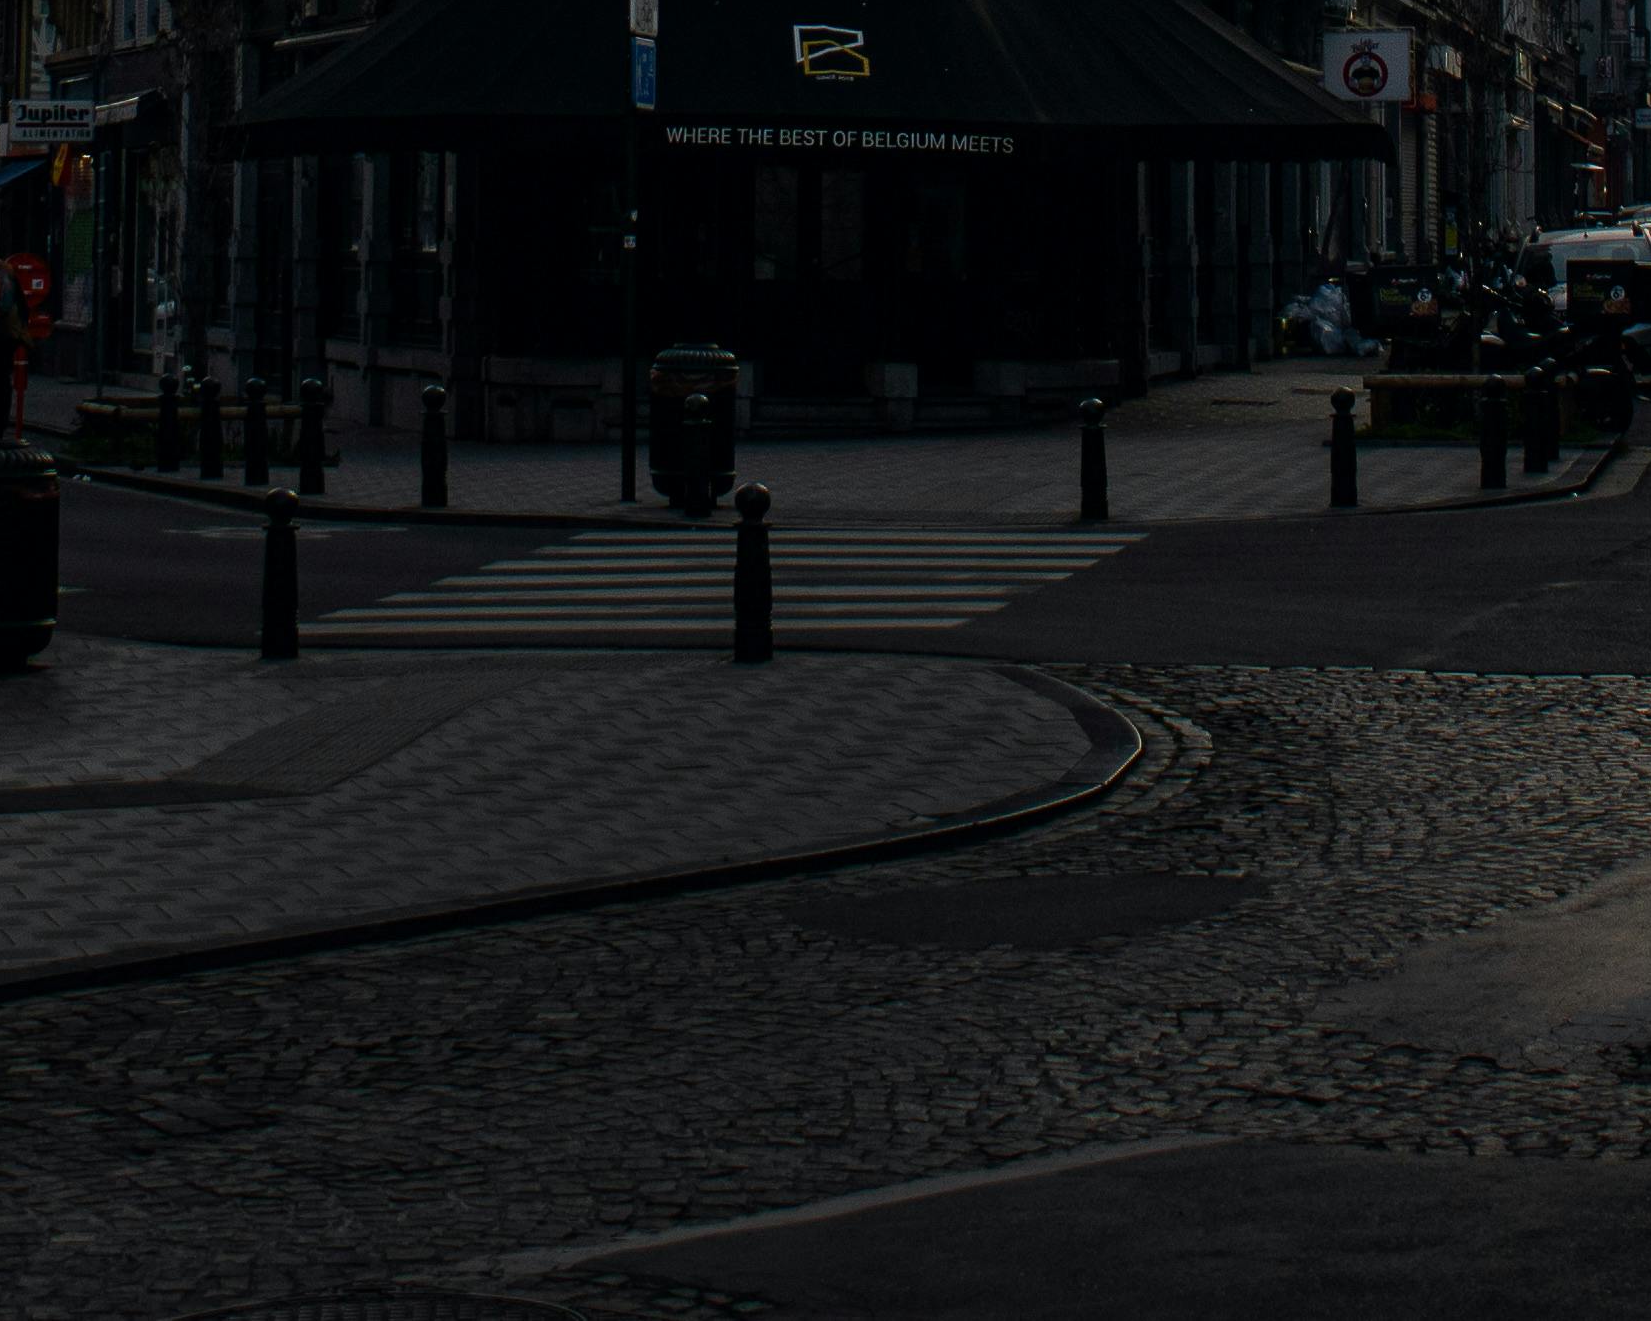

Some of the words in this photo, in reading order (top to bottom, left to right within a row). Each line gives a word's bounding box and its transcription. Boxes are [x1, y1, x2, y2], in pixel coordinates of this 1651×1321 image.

[19, 104, 89, 123] Jupiler
[22, 129, 91, 138] ALIMENTATION
[666, 126, 732, 146] WHERE
[737, 127, 774, 146] THE
[779, 129, 828, 147] BEST
[833, 130, 857, 148] OF
[861, 131, 946, 151] BELGIUM
[952, 133, 1015, 154] MEETS
